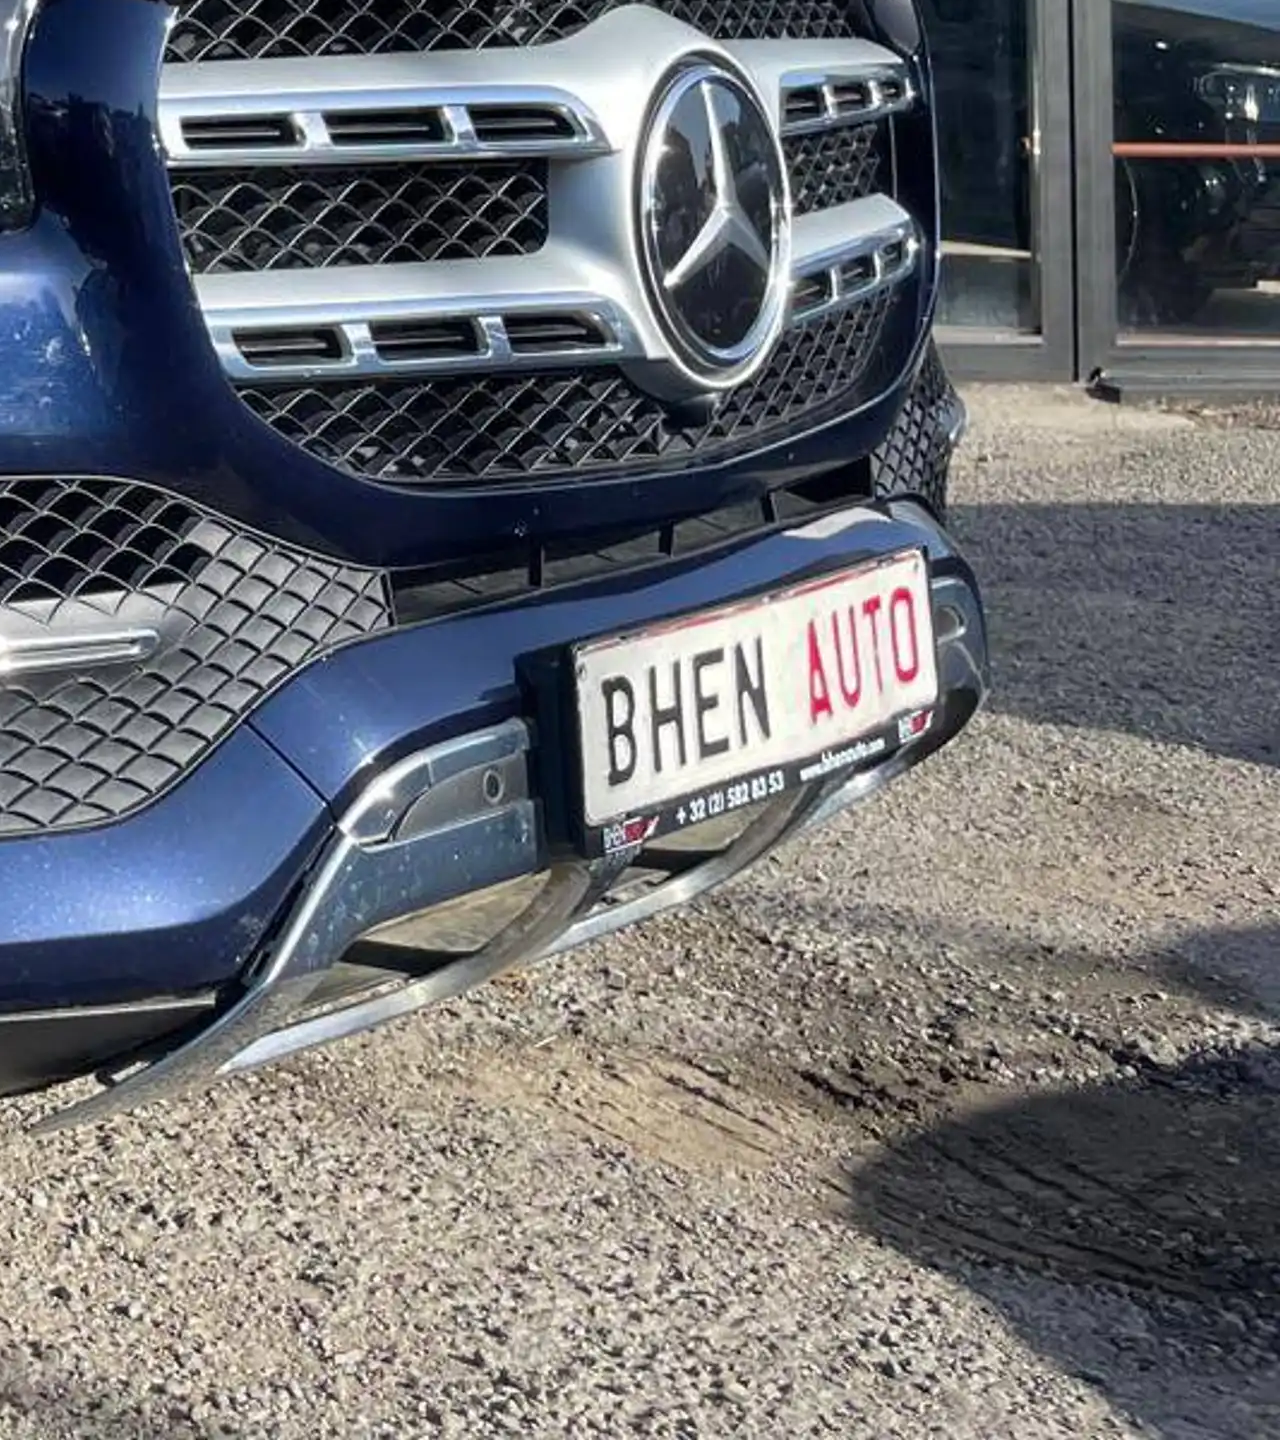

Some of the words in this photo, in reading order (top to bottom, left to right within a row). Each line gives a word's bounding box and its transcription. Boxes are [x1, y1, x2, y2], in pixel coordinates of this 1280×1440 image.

[601, 637, 771, 786] BHEN
[805, 586, 920, 724] AUTO
[689, 797, 706, 823] 32
